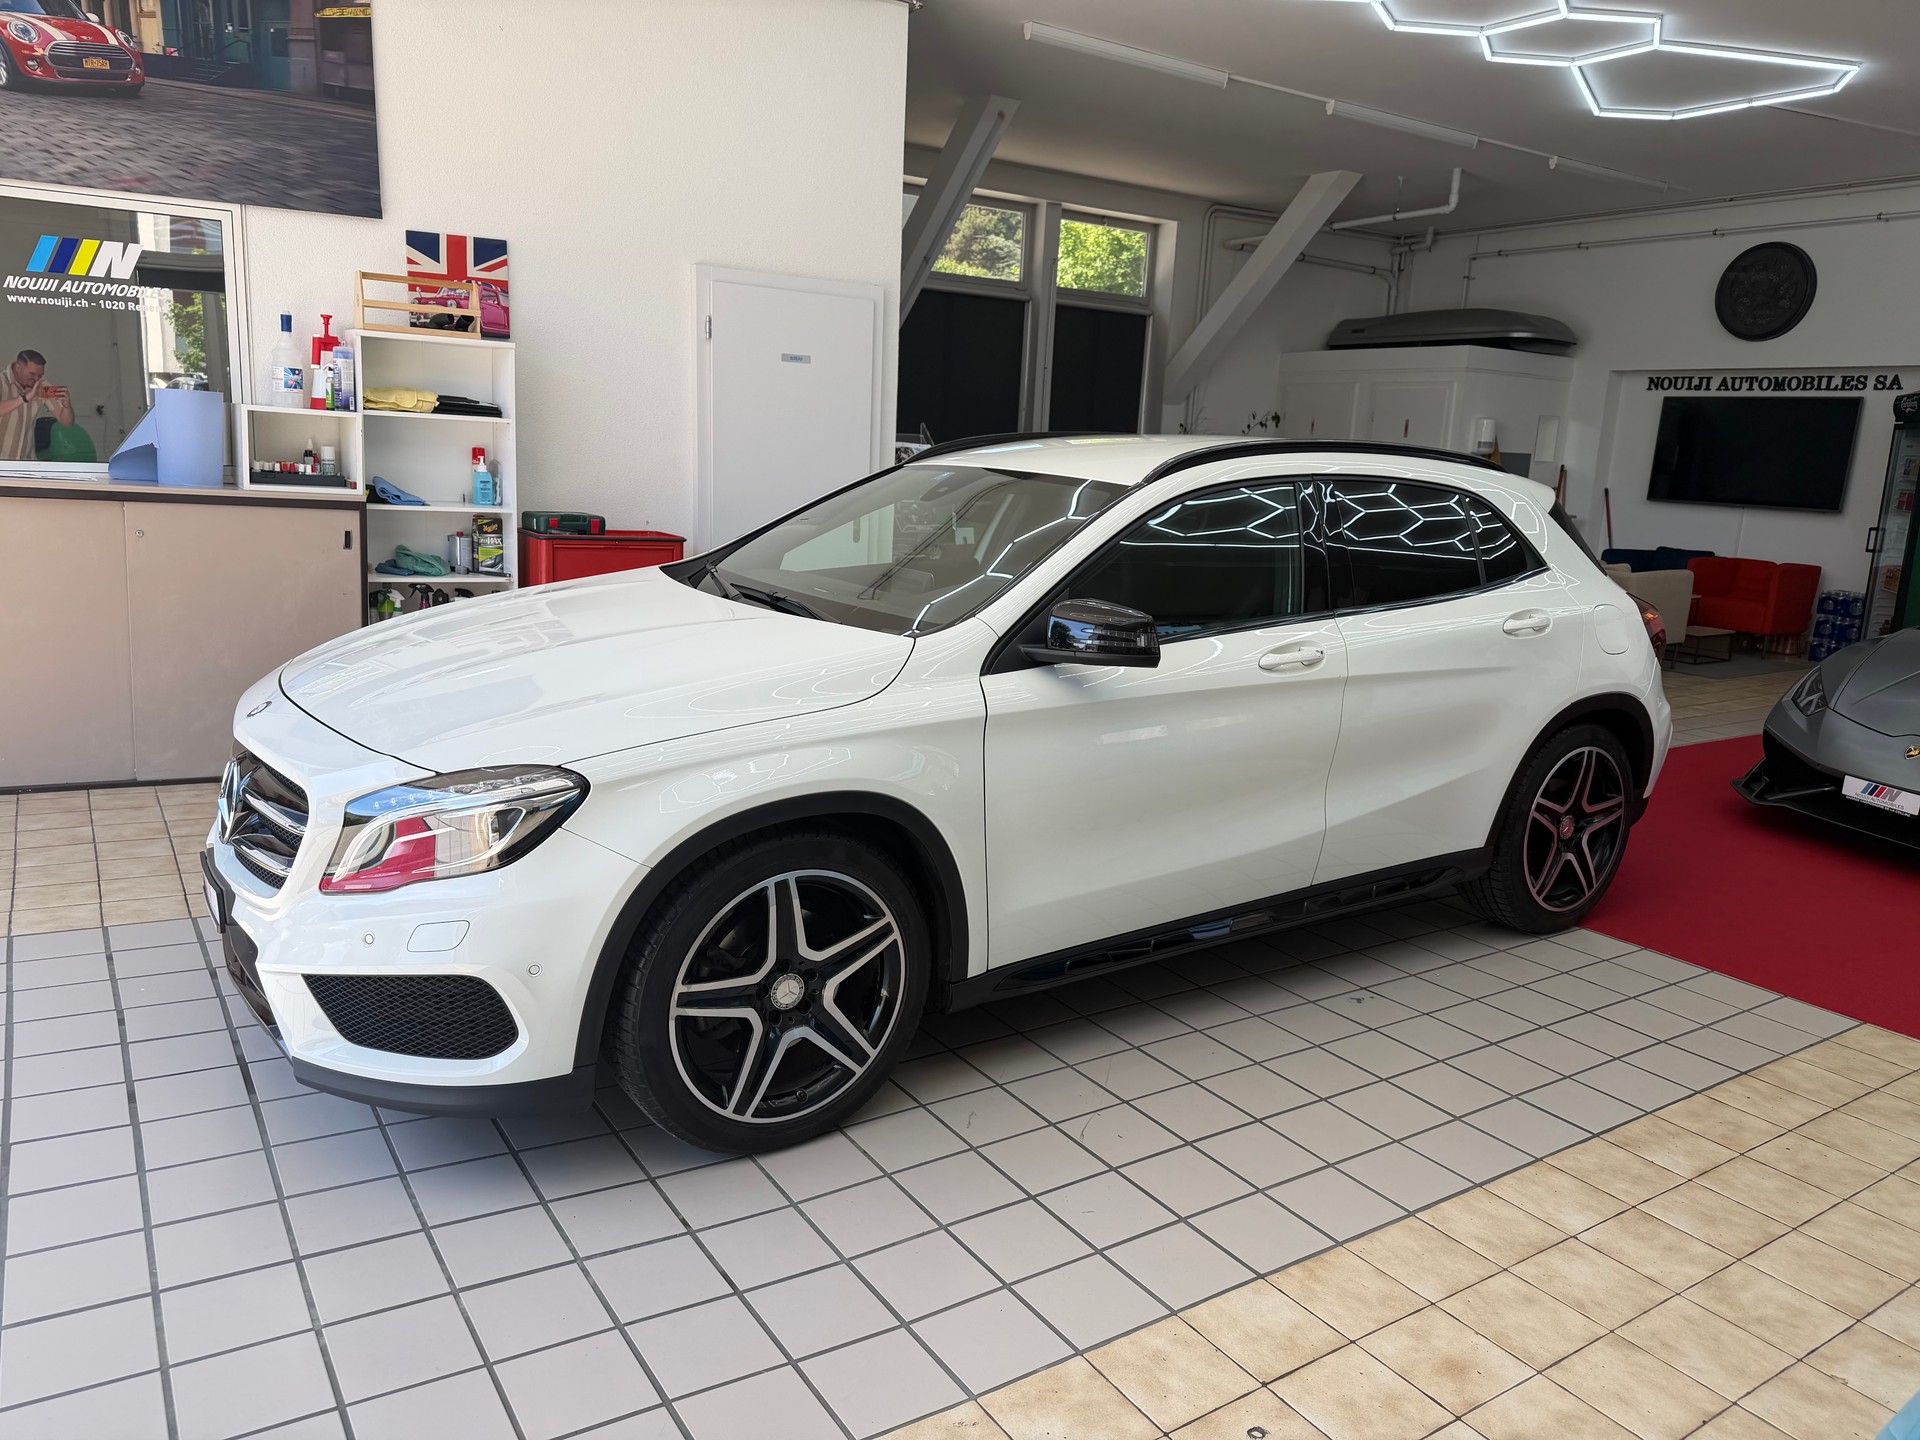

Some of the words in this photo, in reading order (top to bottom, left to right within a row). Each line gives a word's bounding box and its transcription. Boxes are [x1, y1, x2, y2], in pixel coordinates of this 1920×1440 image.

[3, 275, 60, 292] NOUIJI
[59, 280, 171, 300] AUTOMOBILES
[7, 293, 88, 308] www.nouiji.ch
[98, 300, 125, 311] 1020
[1646, 376, 1713, 391] NOUIJI
[1716, 375, 1868, 392] AUTOMOBILES
[1873, 374, 1904, 391] SA
